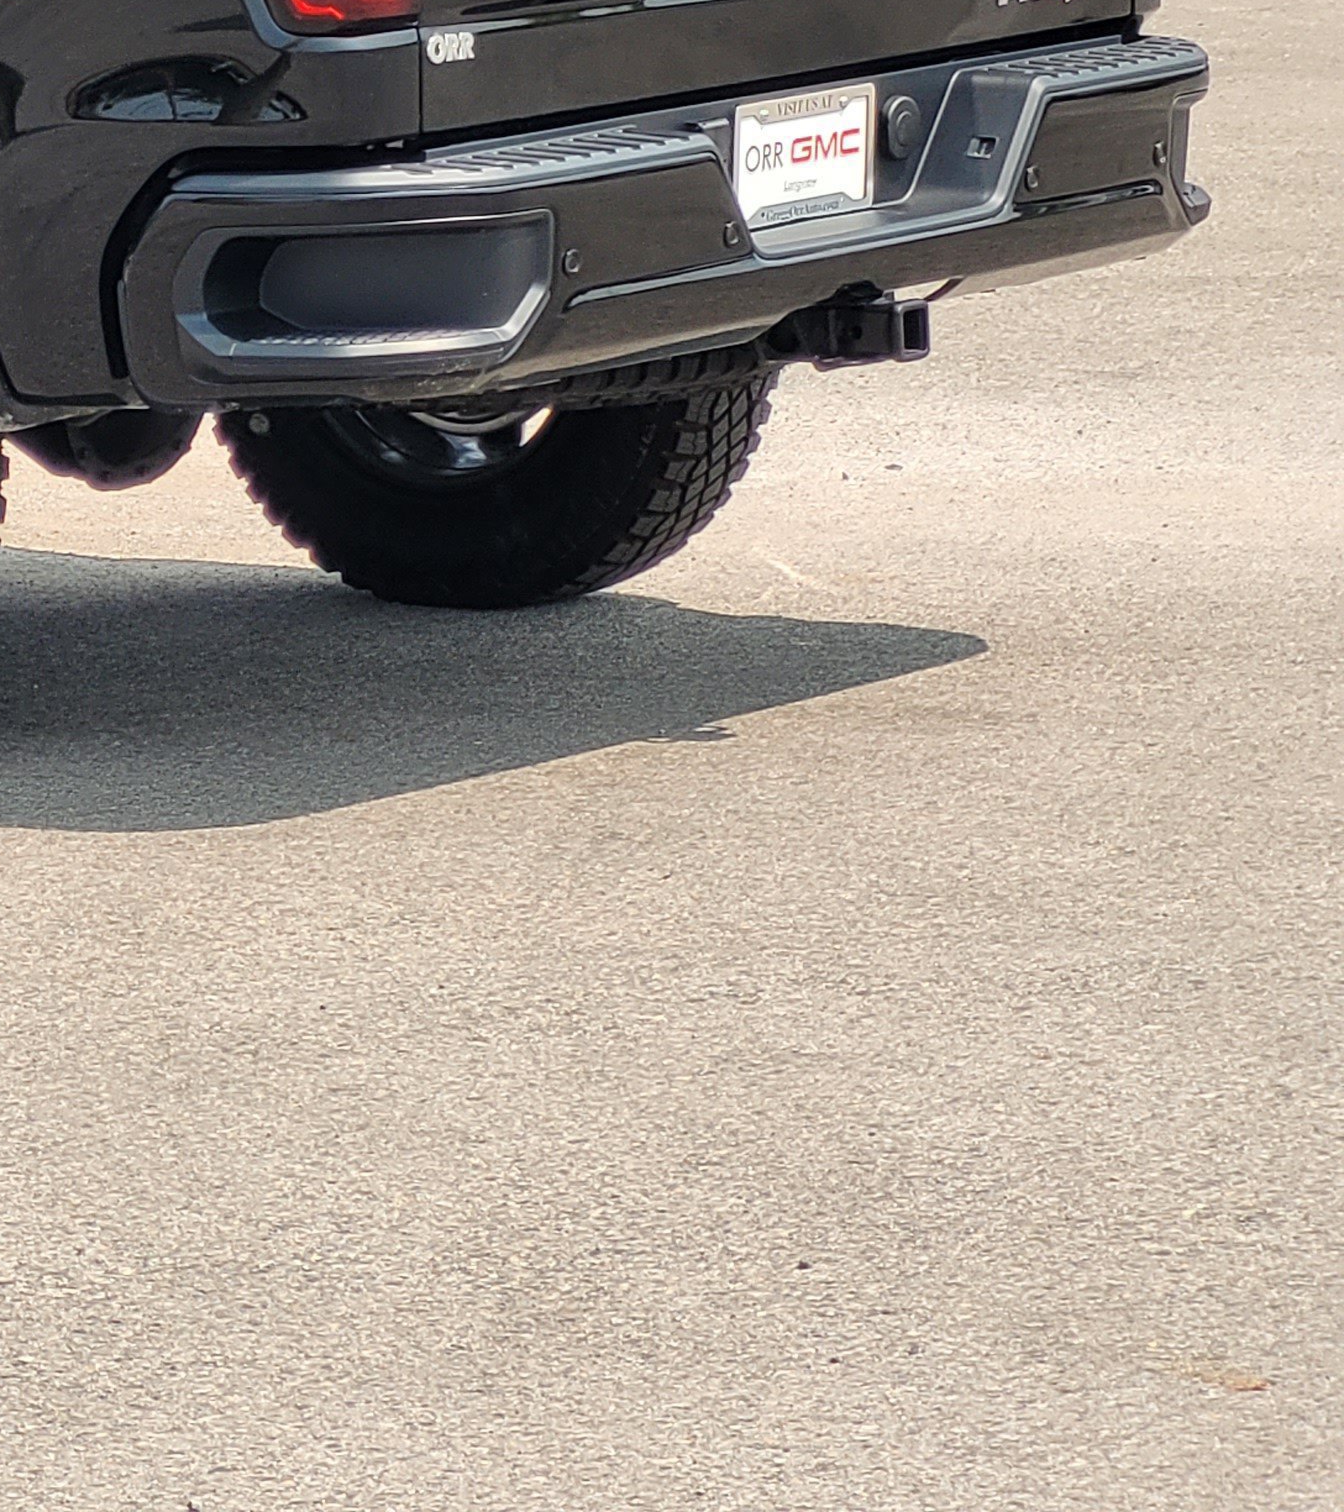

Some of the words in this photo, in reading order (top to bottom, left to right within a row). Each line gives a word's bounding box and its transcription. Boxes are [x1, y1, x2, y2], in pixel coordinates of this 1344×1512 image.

[426, 31, 476, 65] ORR
[745, 142, 784, 172] ORR
[791, 128, 860, 164] GMC
